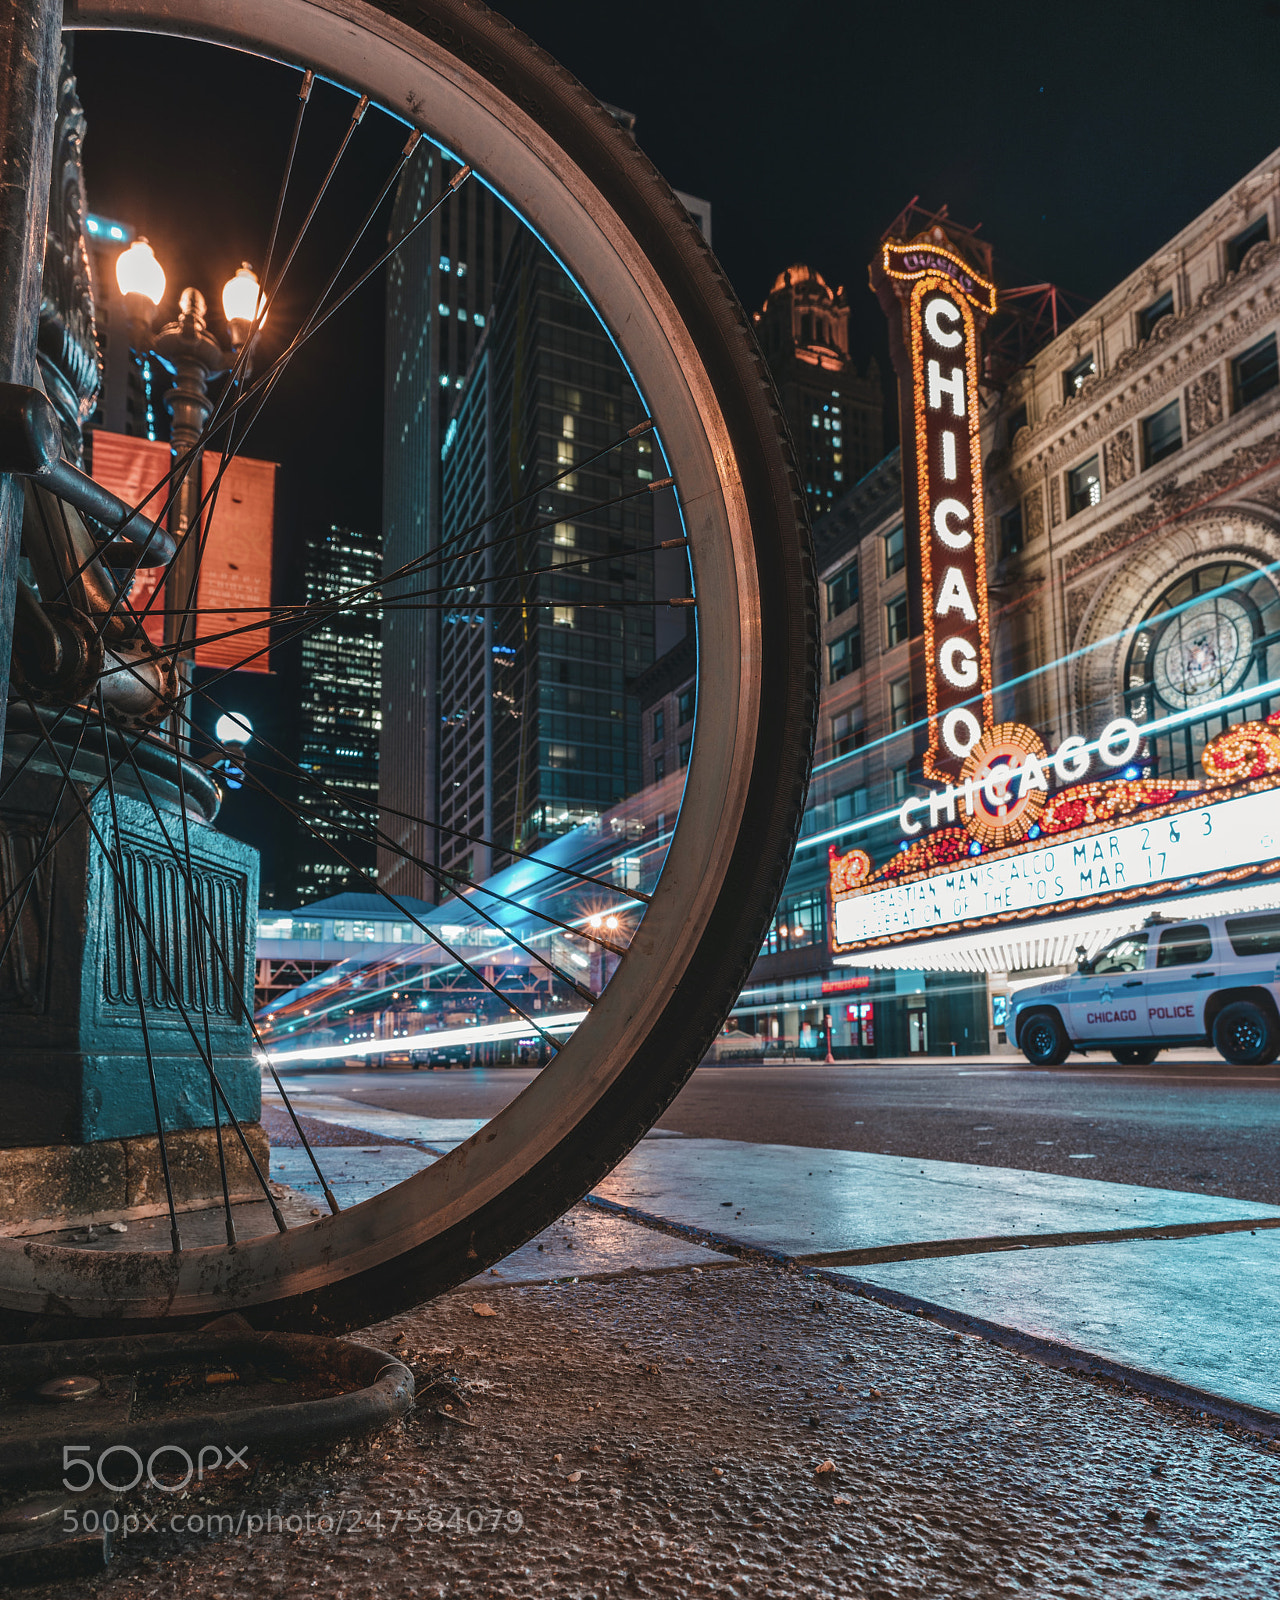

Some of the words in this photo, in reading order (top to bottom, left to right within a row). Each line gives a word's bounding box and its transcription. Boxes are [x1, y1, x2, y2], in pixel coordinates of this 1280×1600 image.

[924, 298, 982, 758] CHICAGO
[899, 717, 1141, 835] CHICAGO
[856, 904, 941, 937] EEBRATON
[953, 895, 969, 917] OF
[983, 887, 1013, 911] THE
[1080, 863, 1126, 892] MAR
[1148, 852, 1167, 878] 17
[866, 883, 936, 914] EBASTIAN
[1073, 836, 1120, 866] MAR
[1141, 828, 1151, 851] 2
[1201, 812, 1213, 836] 3
[1087, 1009, 1136, 1024] CHICAGO
[1148, 1005, 1195, 1020] POLICE
